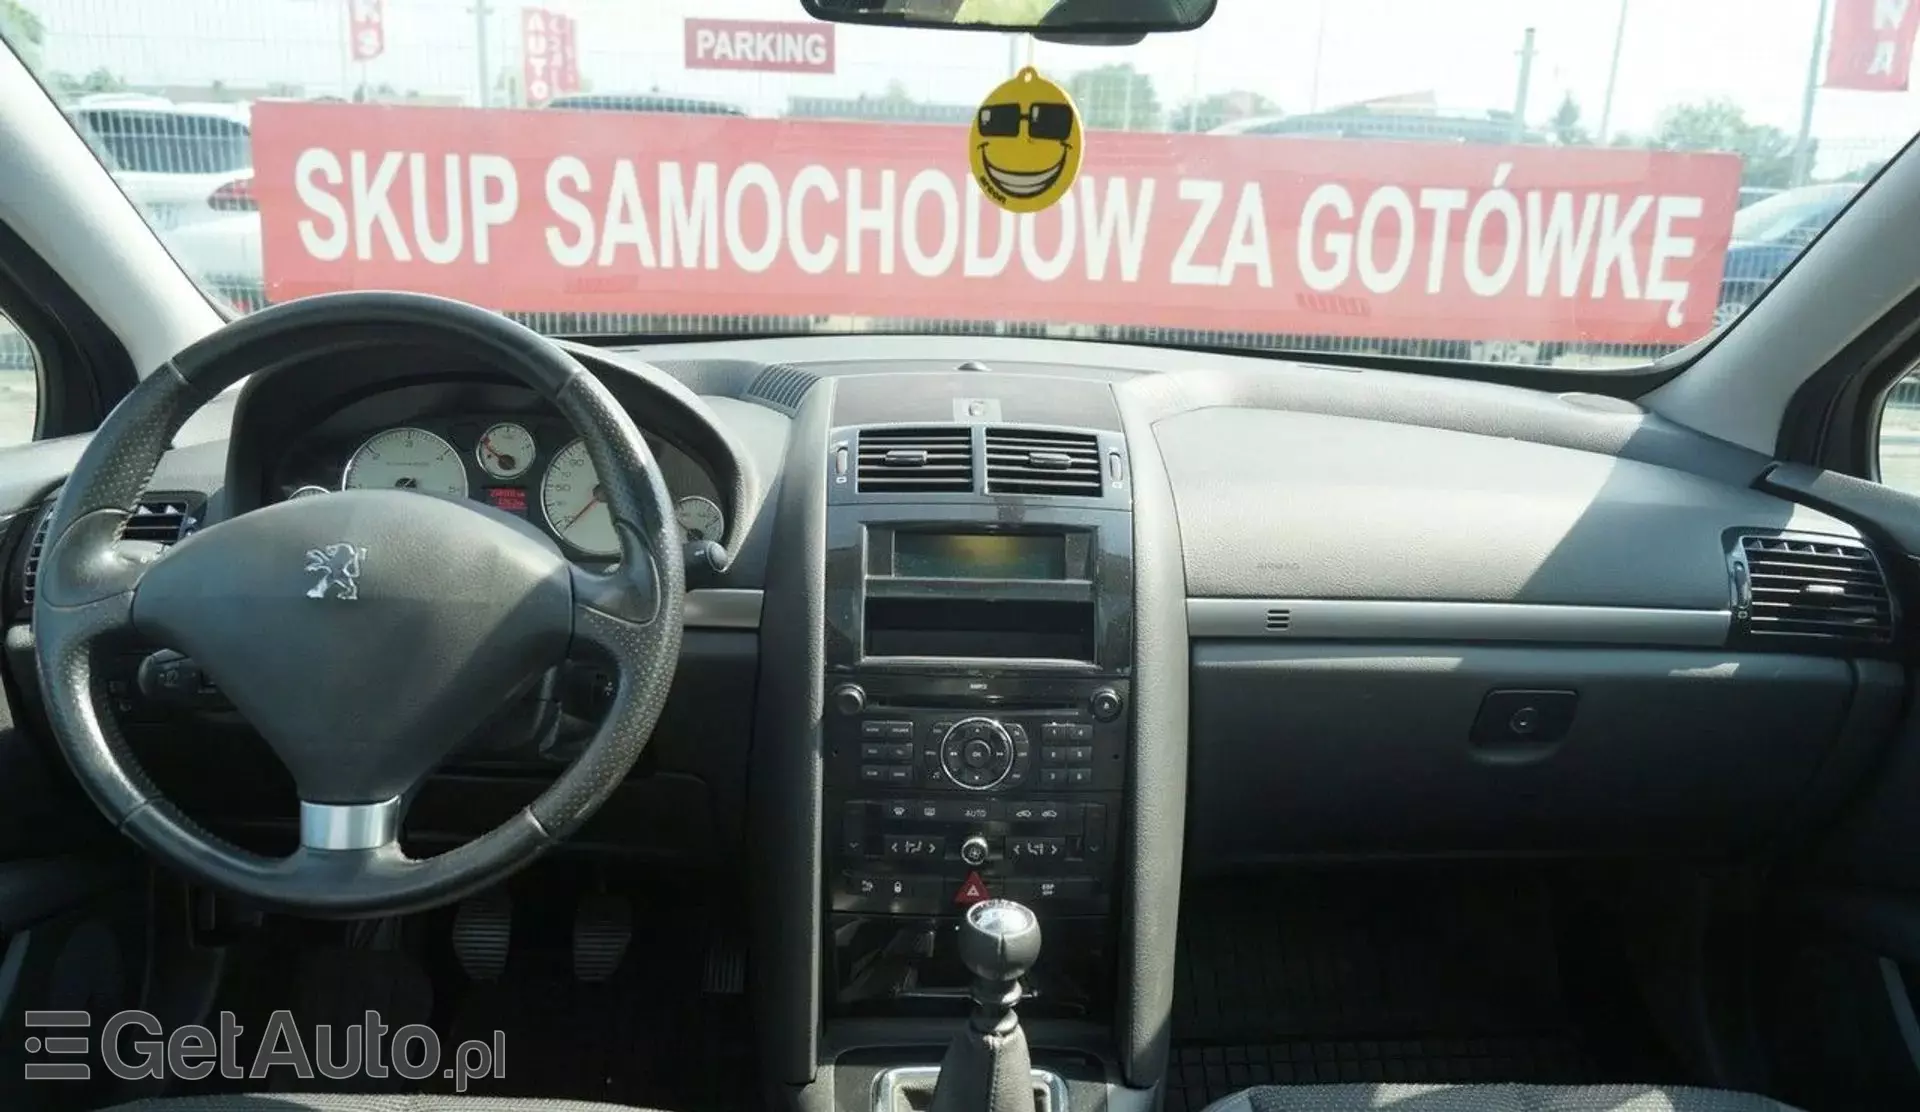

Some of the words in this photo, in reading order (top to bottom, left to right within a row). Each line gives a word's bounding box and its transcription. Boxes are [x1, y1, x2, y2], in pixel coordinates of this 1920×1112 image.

[526, 12, 549, 100] AUTO
[697, 29, 827, 63] PARKING
[295, 147, 518, 264] SKUP
[1170, 180, 1273, 288] ZA
[1299, 163, 1704, 328] GOTÓWKĘ
[964, 809, 987, 818] AUTO
